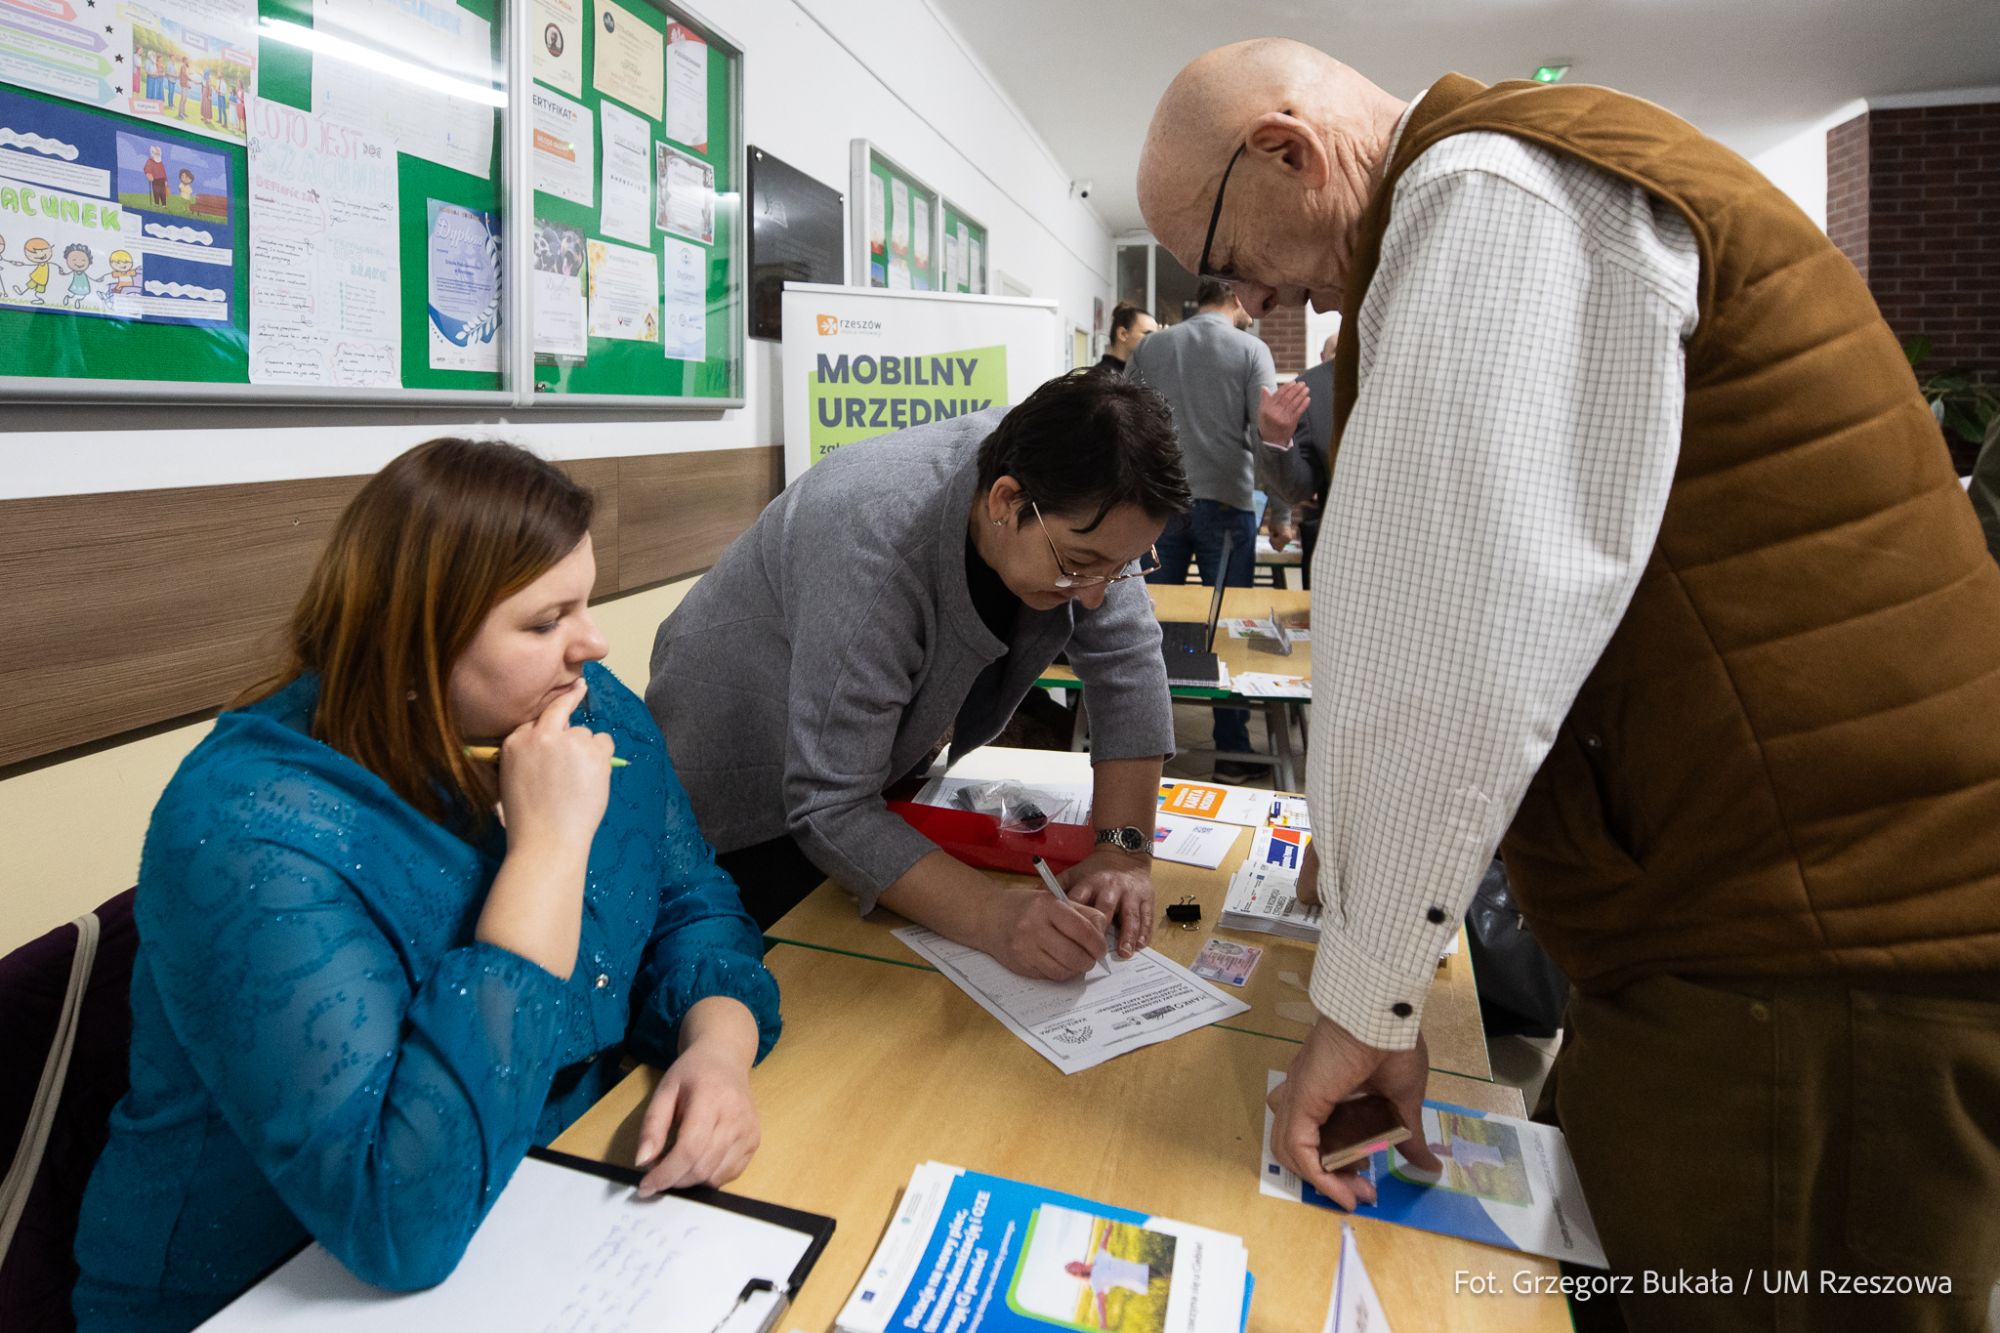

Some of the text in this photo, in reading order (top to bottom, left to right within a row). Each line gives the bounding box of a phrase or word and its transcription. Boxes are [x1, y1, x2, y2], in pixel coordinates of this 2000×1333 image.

[532, 94, 572, 120] ERTYFIKAT
[840, 319, 882, 330] rzeszów
[817, 353, 979, 387] MOBILNY
